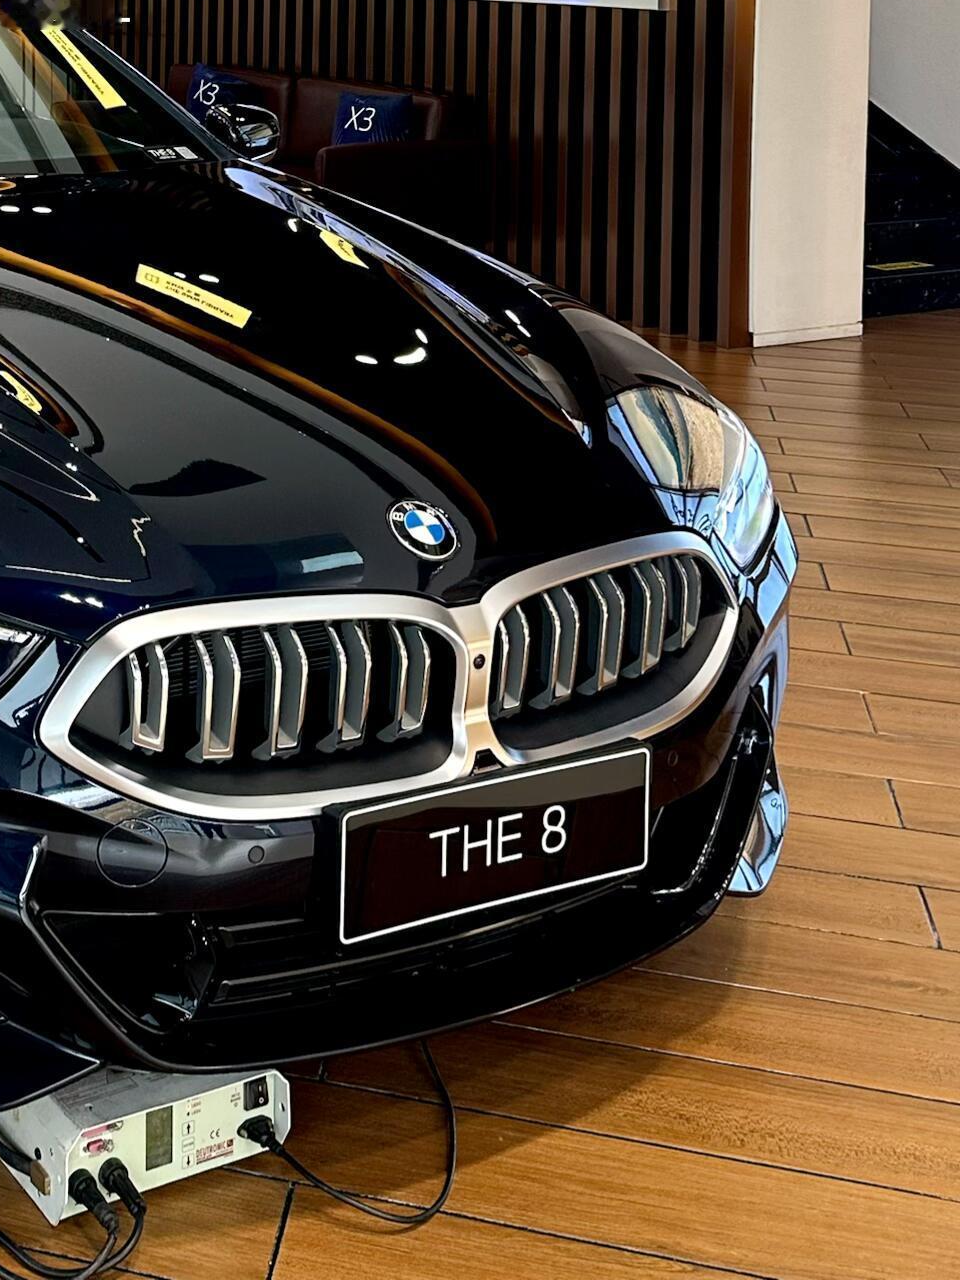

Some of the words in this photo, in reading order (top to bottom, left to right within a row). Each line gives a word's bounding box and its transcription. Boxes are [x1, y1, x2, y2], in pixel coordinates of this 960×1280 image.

[193, 79, 220, 105] X3
[344, 105, 376, 132] X3
[428, 812, 523, 877] THE
[540, 804, 567, 854] 8
